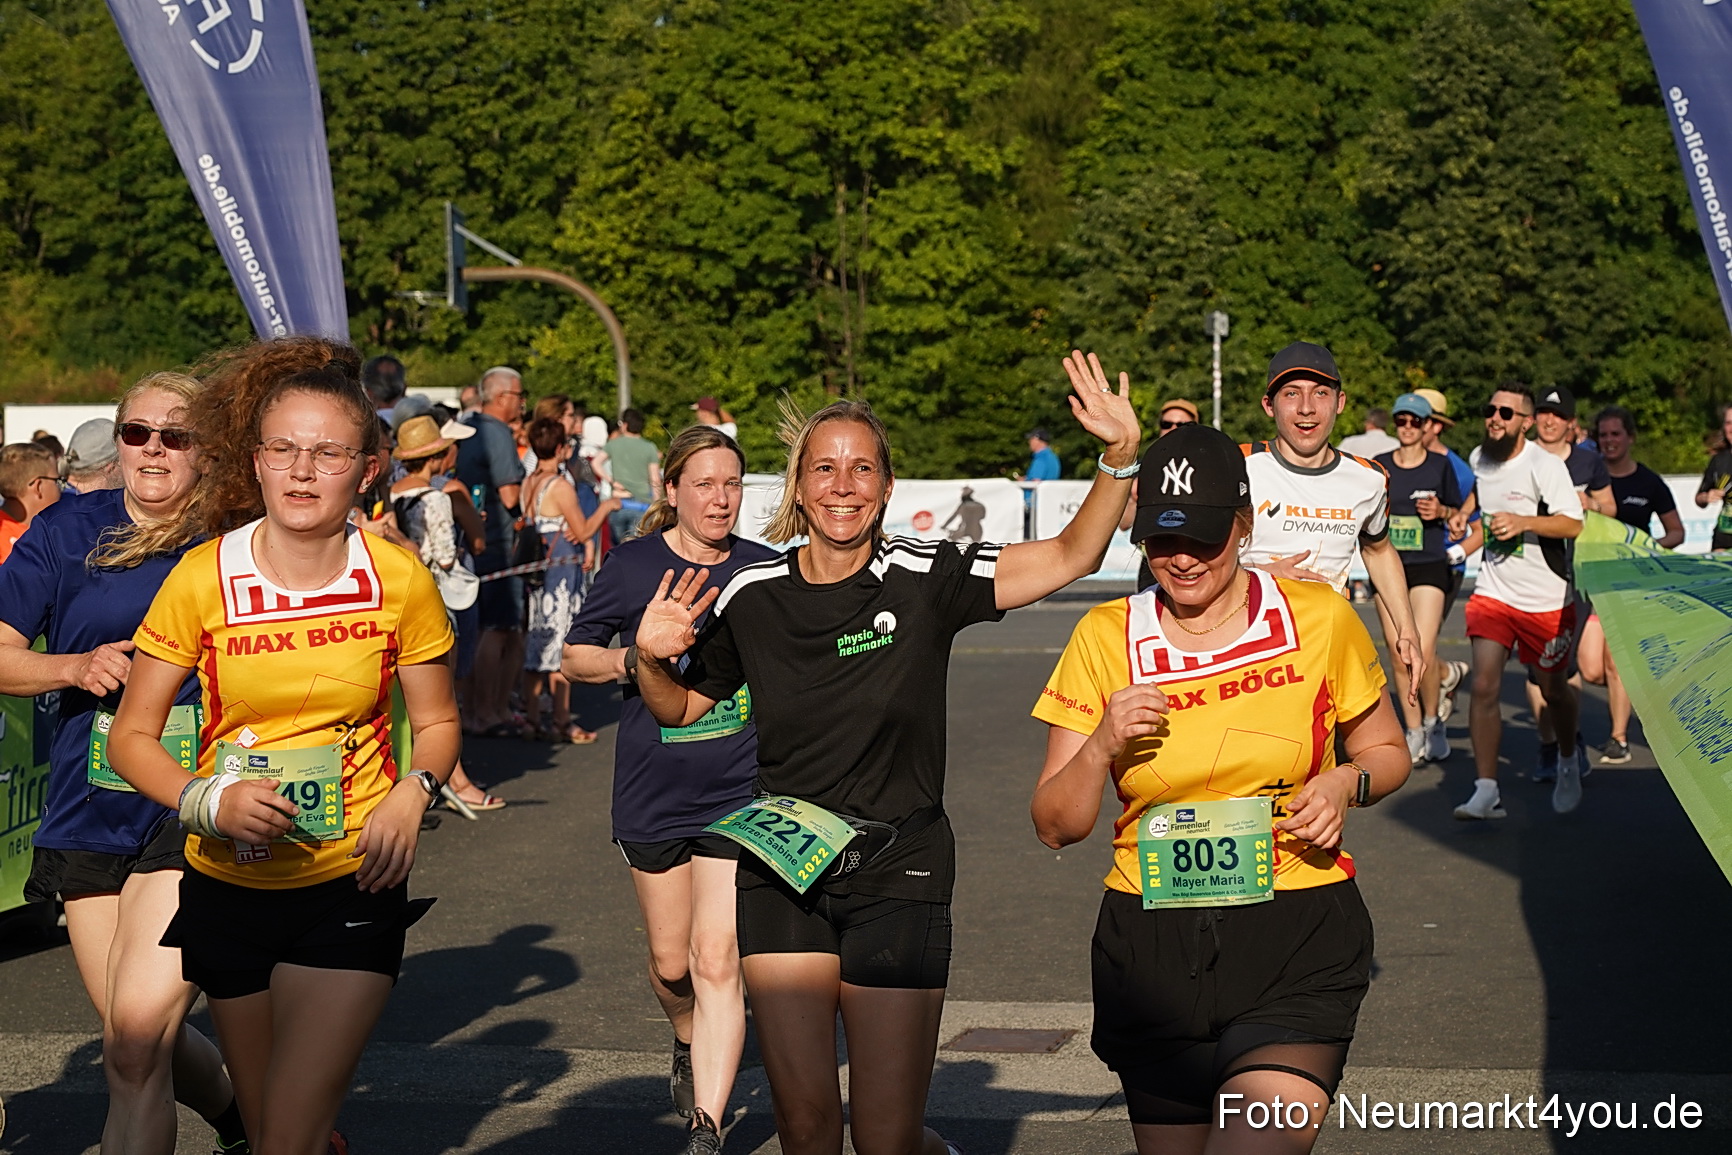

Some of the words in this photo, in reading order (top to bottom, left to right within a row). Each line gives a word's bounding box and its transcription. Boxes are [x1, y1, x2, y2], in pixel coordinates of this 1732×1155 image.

[1286, 504, 1356, 521] KLEBL
[1282, 520, 1356, 536] DYNAMICS
[226, 631, 298, 657] MAX
[306, 620, 383, 648] BÖGL
[837, 629, 874, 649] physio
[839, 634, 894, 657] neumarkt
[1158, 687, 1208, 714] AX
[1219, 663, 1305, 701] BÖGL
[721, 712, 741, 723] Silke
[738, 688, 748, 722] 2022
[92, 741, 101, 770] RUN
[181, 740, 191, 770] 022
[100, 763, 118, 777] Pro
[242, 766, 284, 775] Firmenlauf
[281, 780, 321, 811] 49
[325, 782, 337, 827] 2022
[290, 815, 304, 824] er
[306, 813, 325, 824] Eva
[743, 808, 819, 856] 1221
[1171, 820, 1211, 831] Firmenlauf
[1186, 827, 1210, 835] neumarkt
[8, 832, 35, 859] neu
[732, 821, 766, 840] Pürzer
[765, 837, 798, 867] Sabine
[1172, 836, 1240, 873] 803
[797, 847, 830, 881] 2022
[1147, 852, 1161, 888] RUN
[1255, 839, 1269, 887] 2022
[1172, 877, 1206, 890] Mayer
[1210, 874, 1245, 887] Maria
